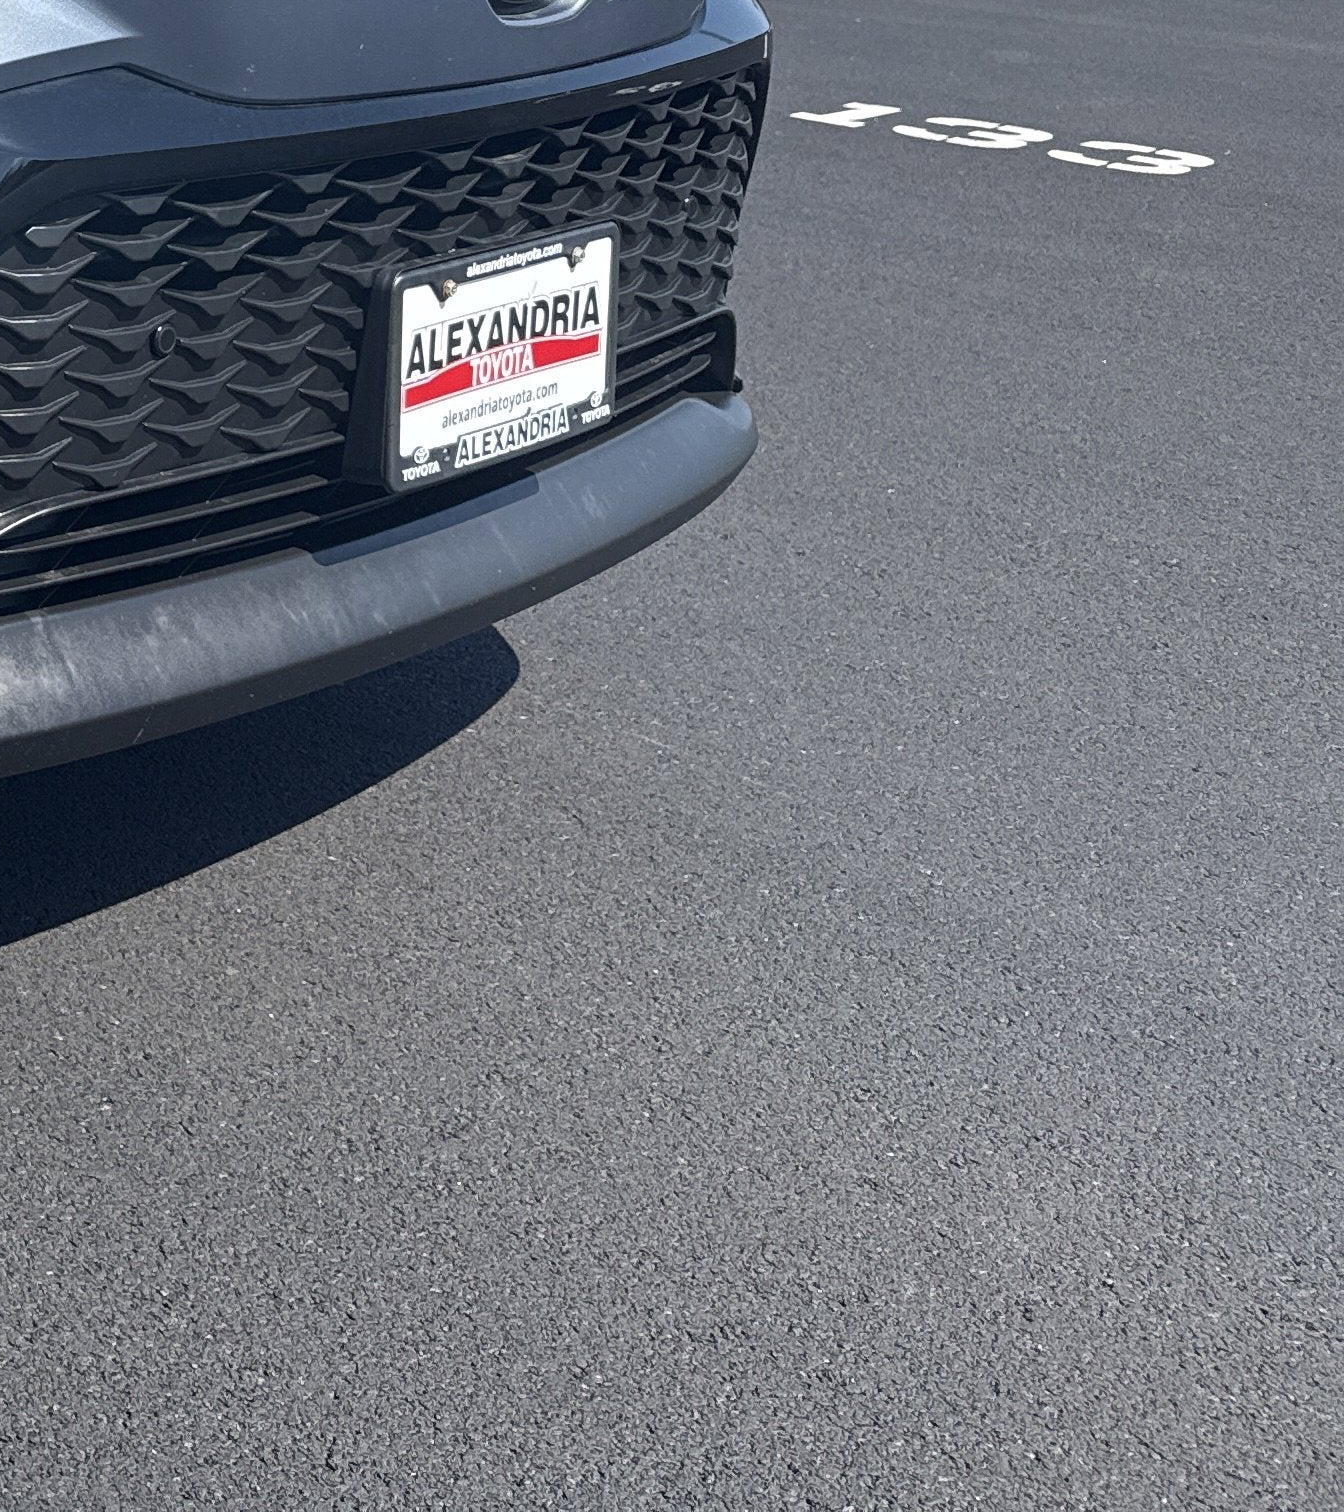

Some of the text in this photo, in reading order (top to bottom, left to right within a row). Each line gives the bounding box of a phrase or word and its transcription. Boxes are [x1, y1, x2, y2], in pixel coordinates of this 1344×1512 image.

[789, 101, 1215, 175] 133
[466, 243, 564, 278] alexandriatoyota.com
[405, 285, 601, 380] ALEXANDRIA
[470, 344, 534, 387] TOYOTA
[442, 382, 558, 429] alexandriatoyota.com
[456, 406, 568, 466] ALEXANDRIA
[401, 460, 442, 482] TOYOTA
